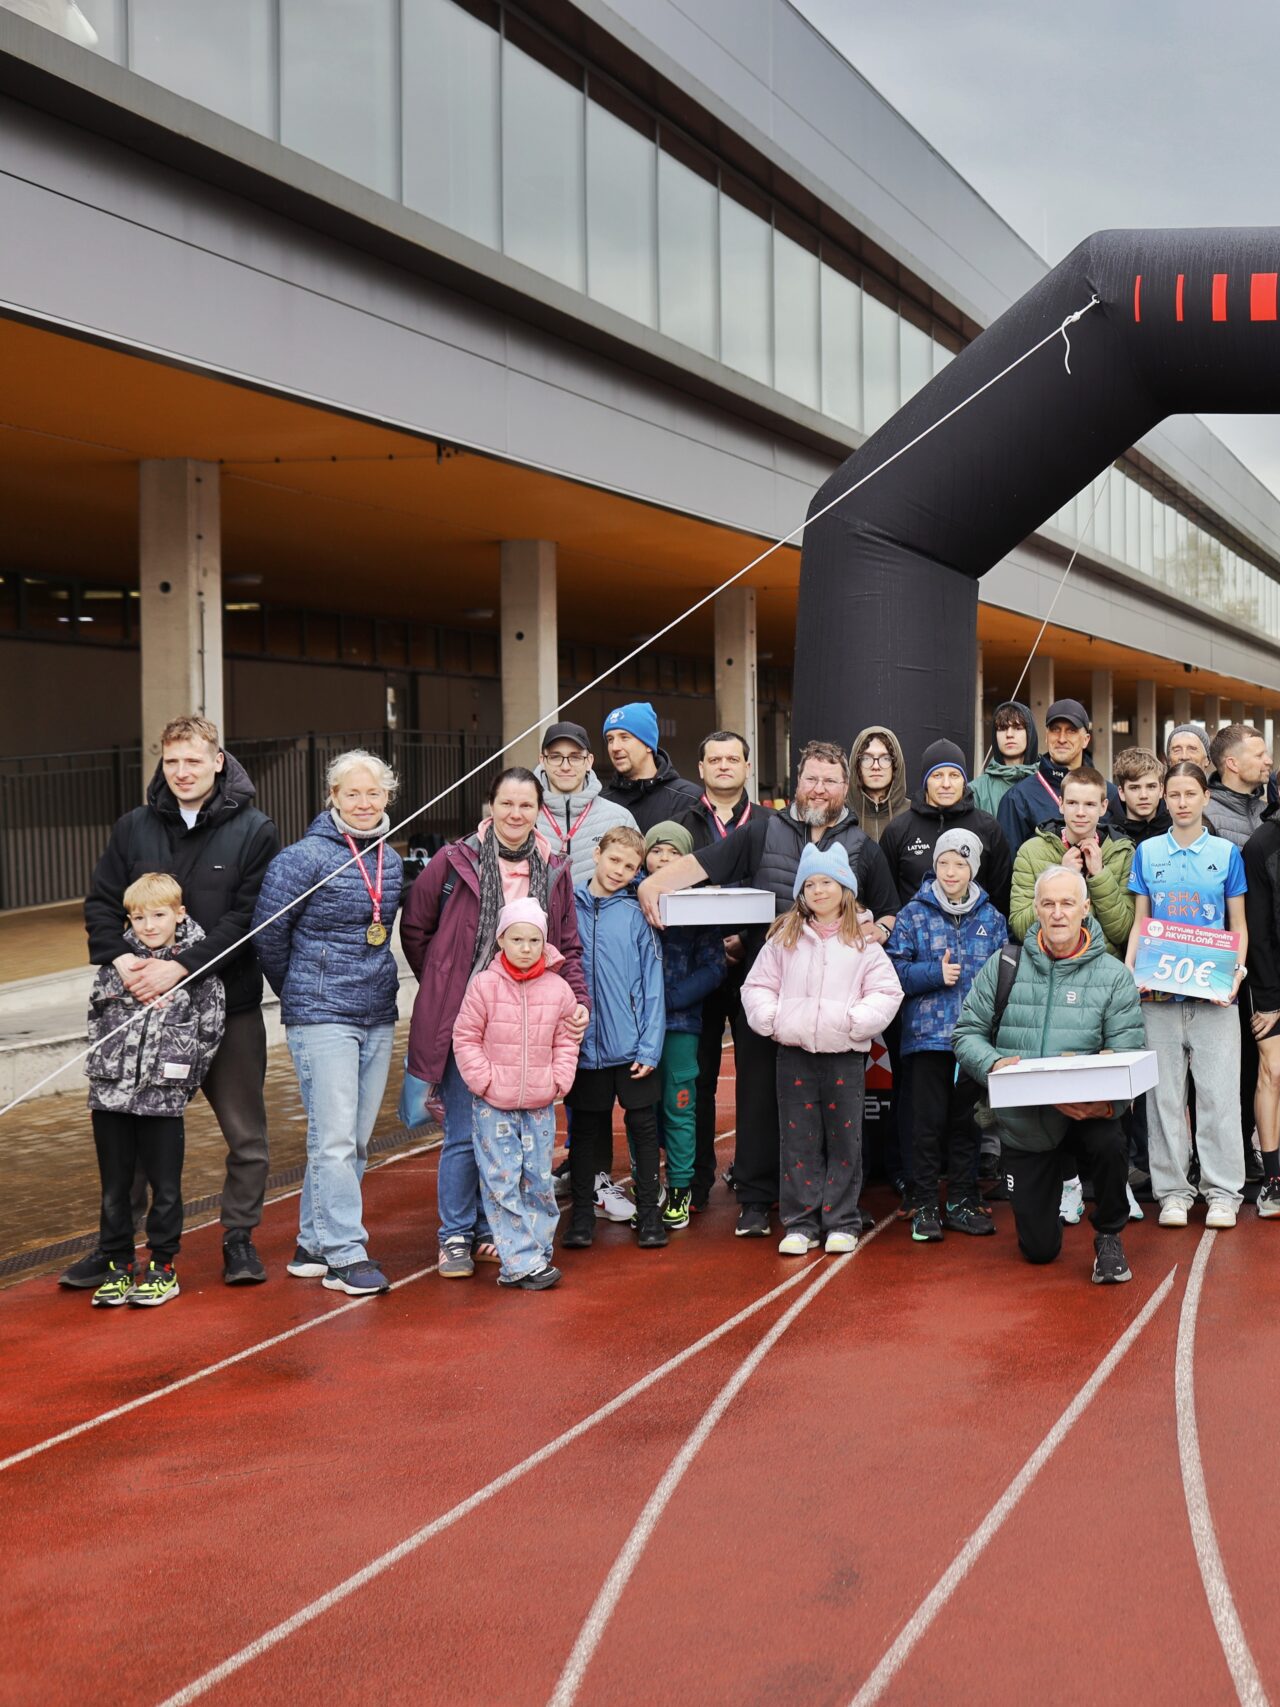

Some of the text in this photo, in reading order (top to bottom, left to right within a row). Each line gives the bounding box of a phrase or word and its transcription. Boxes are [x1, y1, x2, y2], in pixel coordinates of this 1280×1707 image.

[1168, 891, 1200, 904] SHA
[1166, 925, 1197, 935] LATVIJAS
[1165, 932, 1214, 945] AKVATLONĀ
[1153, 954, 1216, 987] 50€
